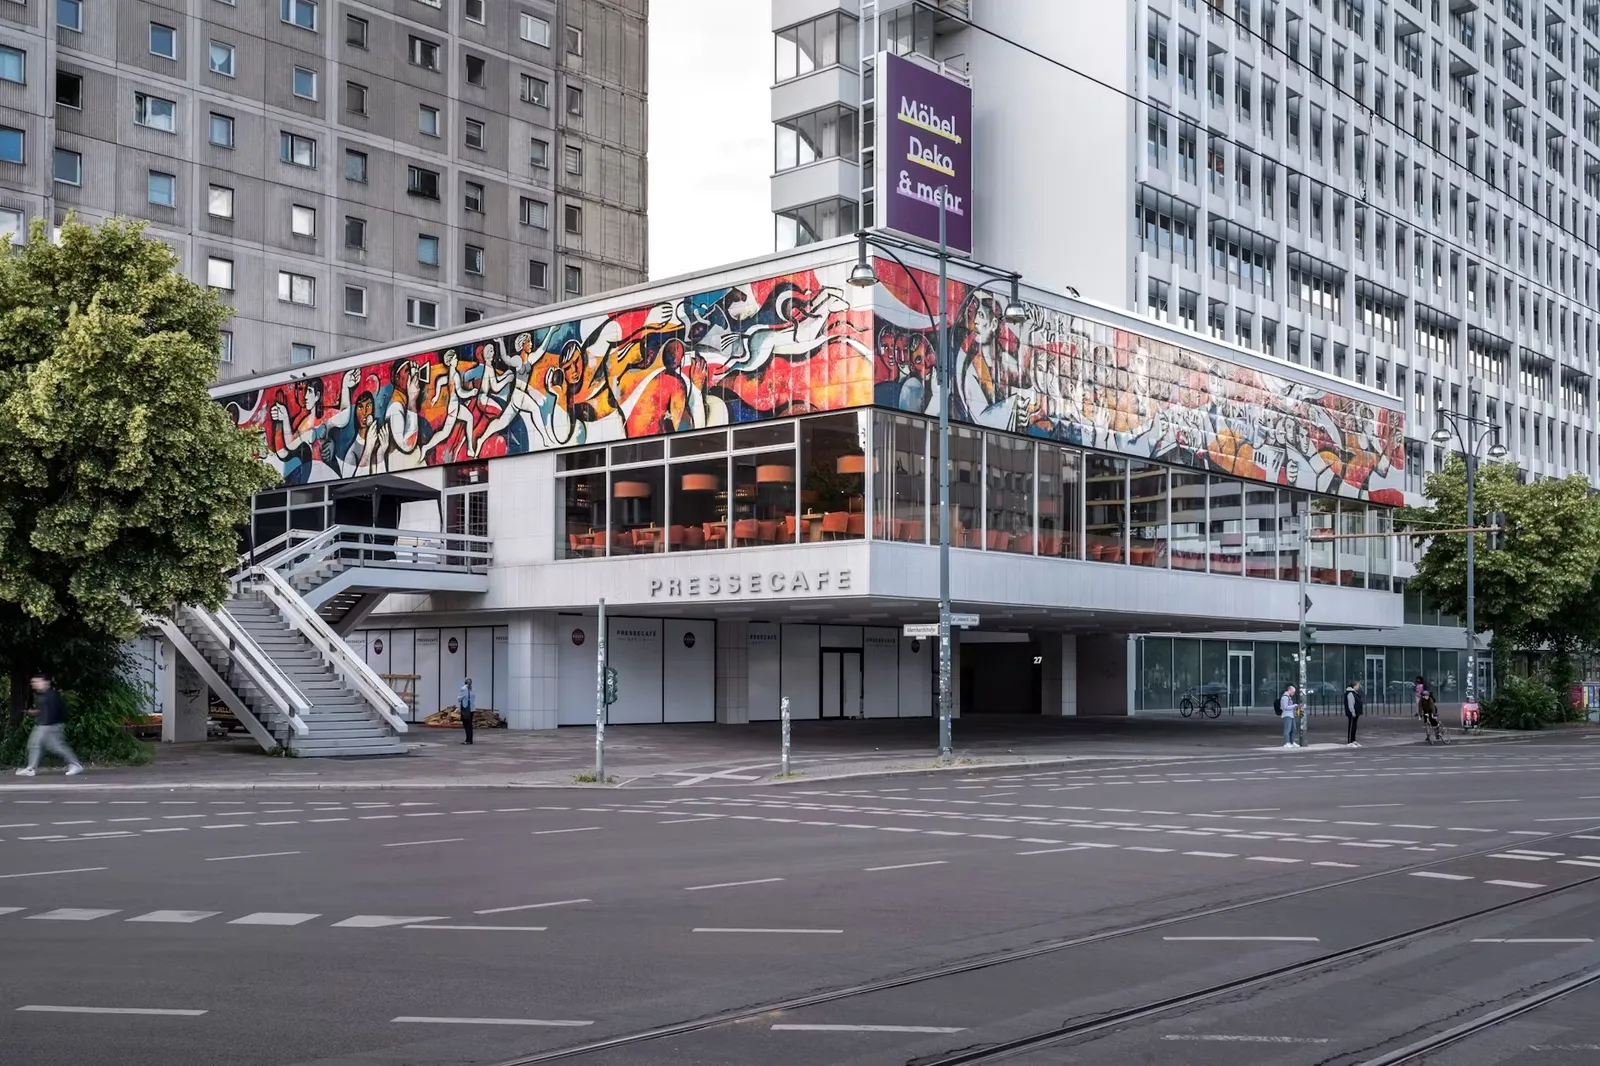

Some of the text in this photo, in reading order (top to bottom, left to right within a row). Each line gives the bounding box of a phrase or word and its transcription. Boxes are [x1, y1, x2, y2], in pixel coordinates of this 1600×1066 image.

[900, 95, 960, 145] Möbel,
[909, 135, 953, 171] Deko
[898, 169, 962, 212] & mehr
[650, 569, 851, 597] PRESSECAFE
[1033, 656, 1043, 664] 27
